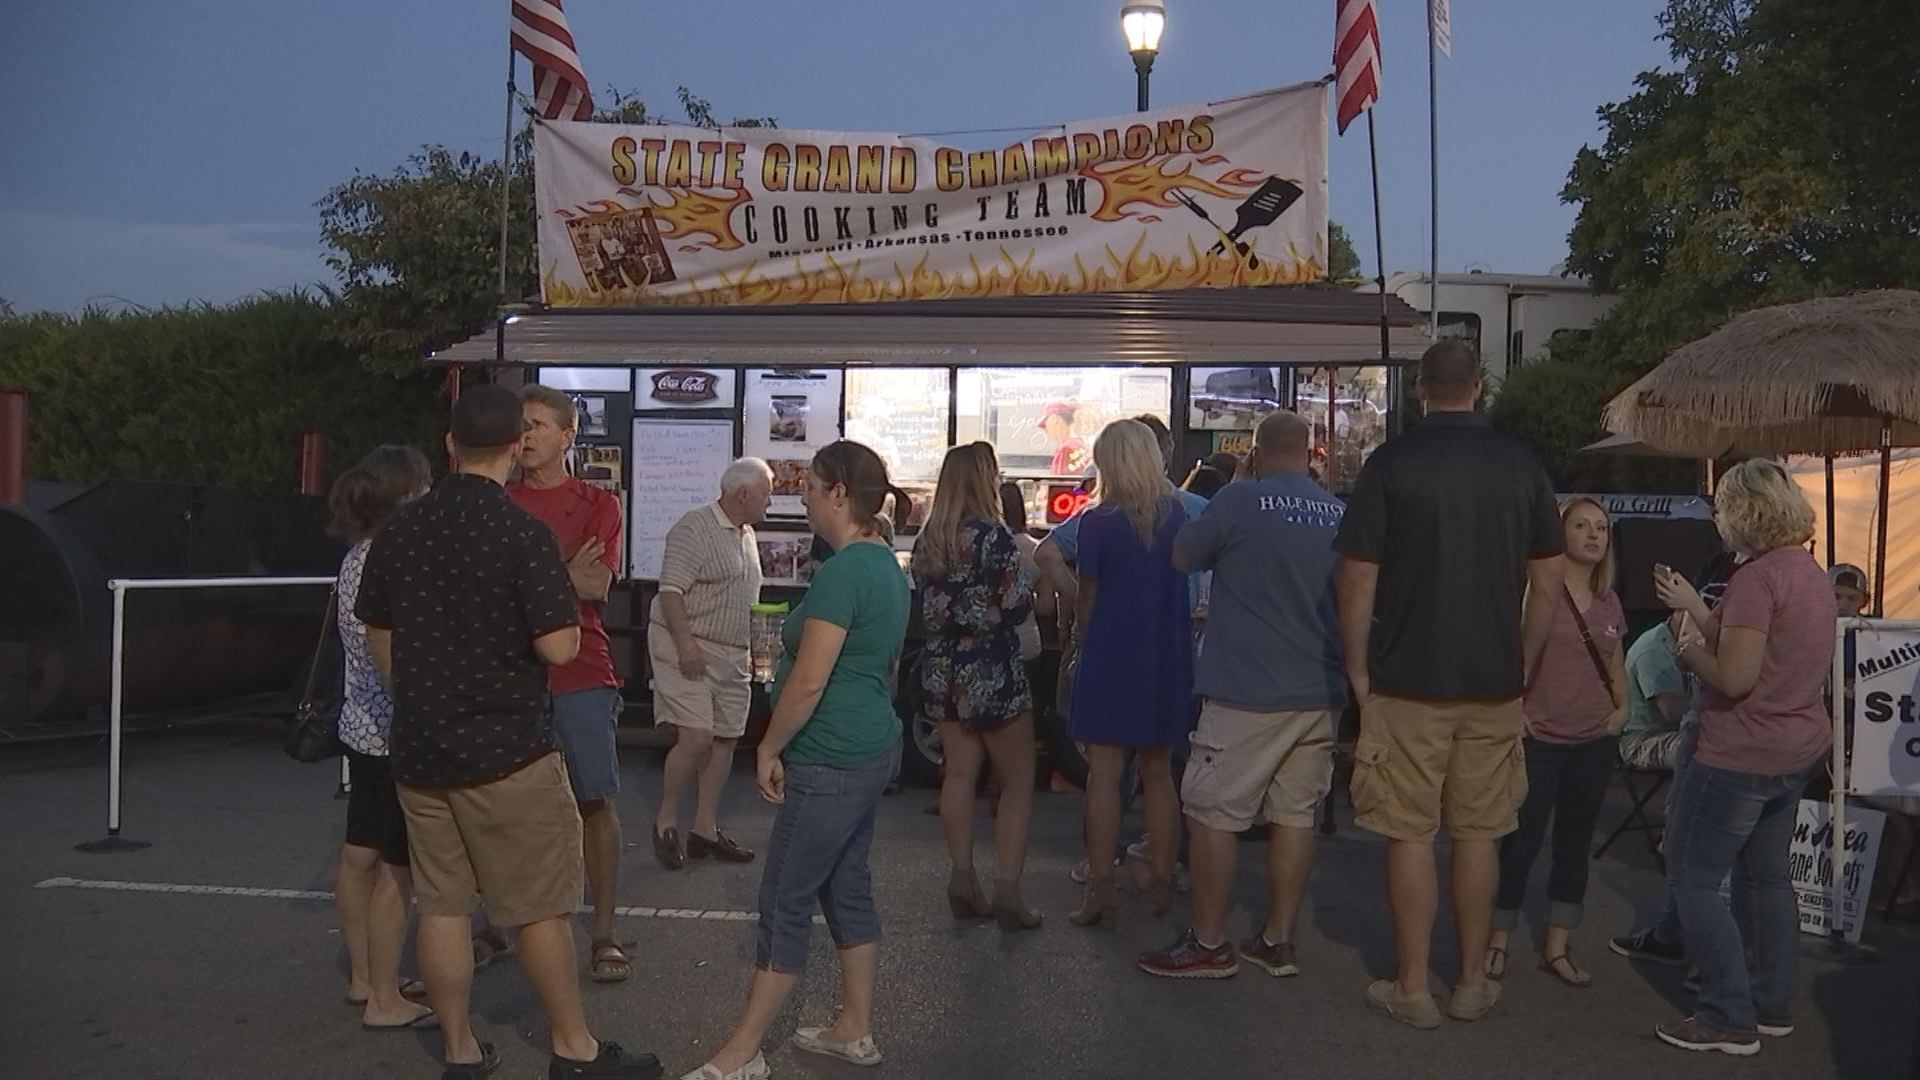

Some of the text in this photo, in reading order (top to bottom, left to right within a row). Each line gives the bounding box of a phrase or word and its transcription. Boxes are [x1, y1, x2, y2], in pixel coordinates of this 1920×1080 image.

[611, 115, 1216, 193] STATE GRAND CHAMPIONS
[744, 178, 1088, 245] COOKING TEAM
[1631, 496, 1673, 512] Grill
[1864, 690, 1920, 723] St
